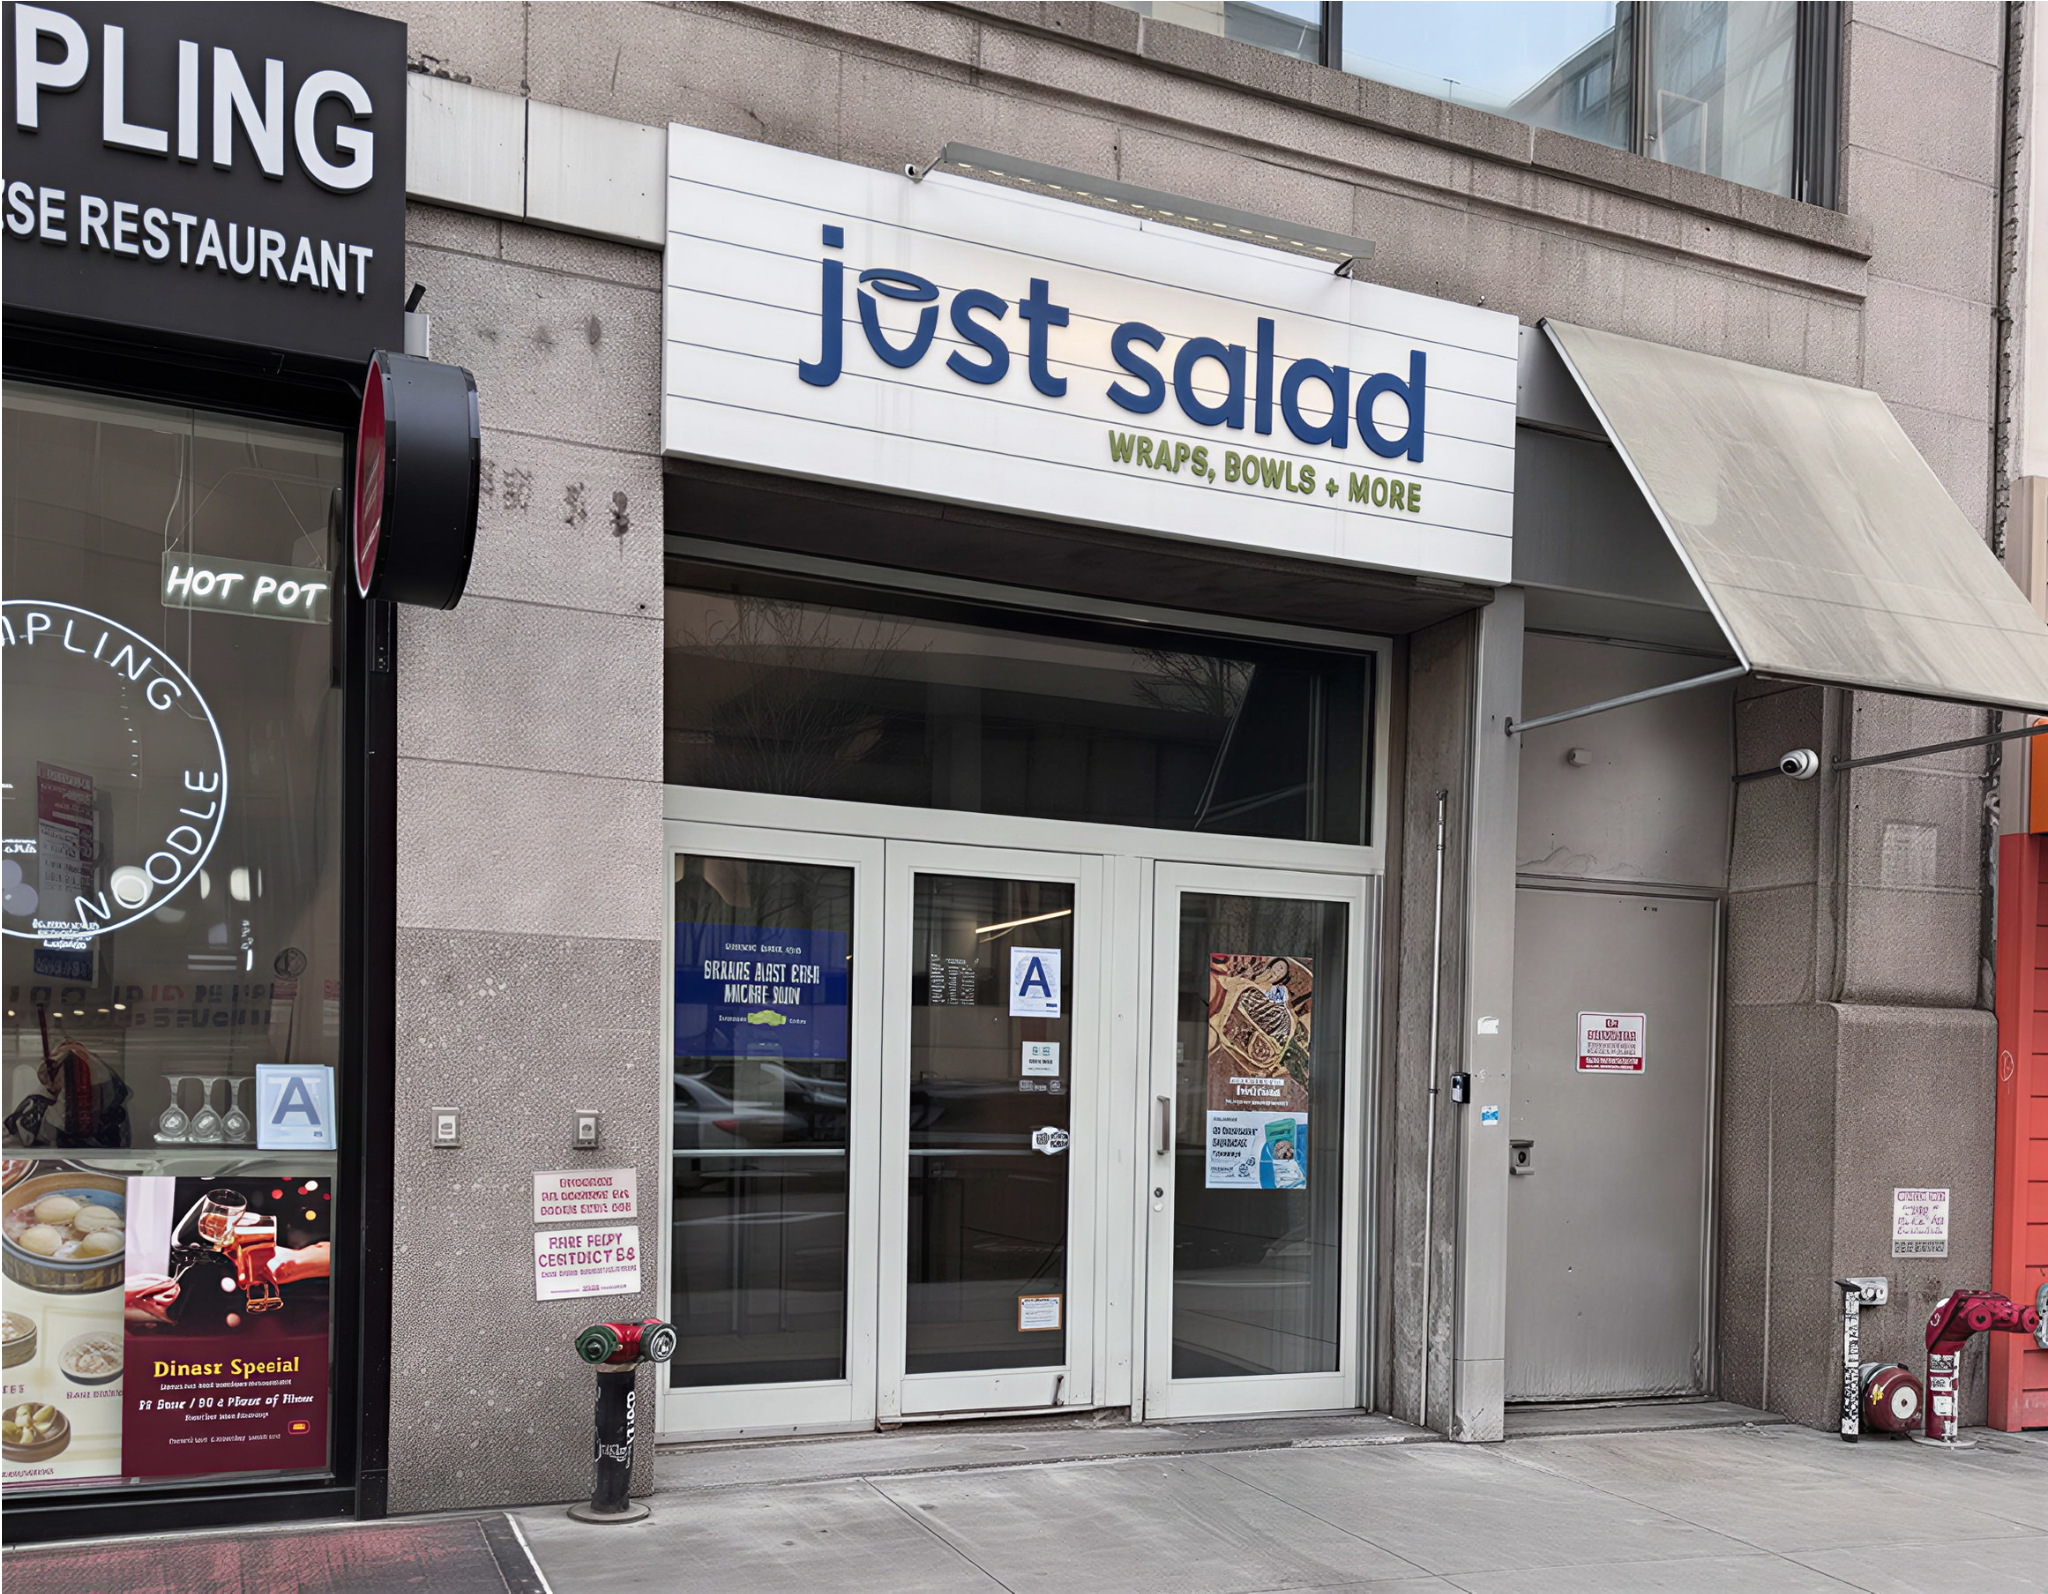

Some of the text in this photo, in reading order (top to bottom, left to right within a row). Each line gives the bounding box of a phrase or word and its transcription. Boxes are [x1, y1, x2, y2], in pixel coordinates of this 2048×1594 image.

[14, 3, 374, 195] PLING
[2, 178, 374, 298] SE RESTAURANT
[799, 223, 1427, 463] just salad
[1108, 429, 1216, 485] WRAPS,
[1224, 450, 1316, 495] BOWLS
[1348, 471, 1422, 513] MORE
[166, 564, 328, 608] HOT POT
[73, 769, 220, 931] NOODLE
[1018, 955, 1052, 998] A
[271, 1076, 321, 1126] A
